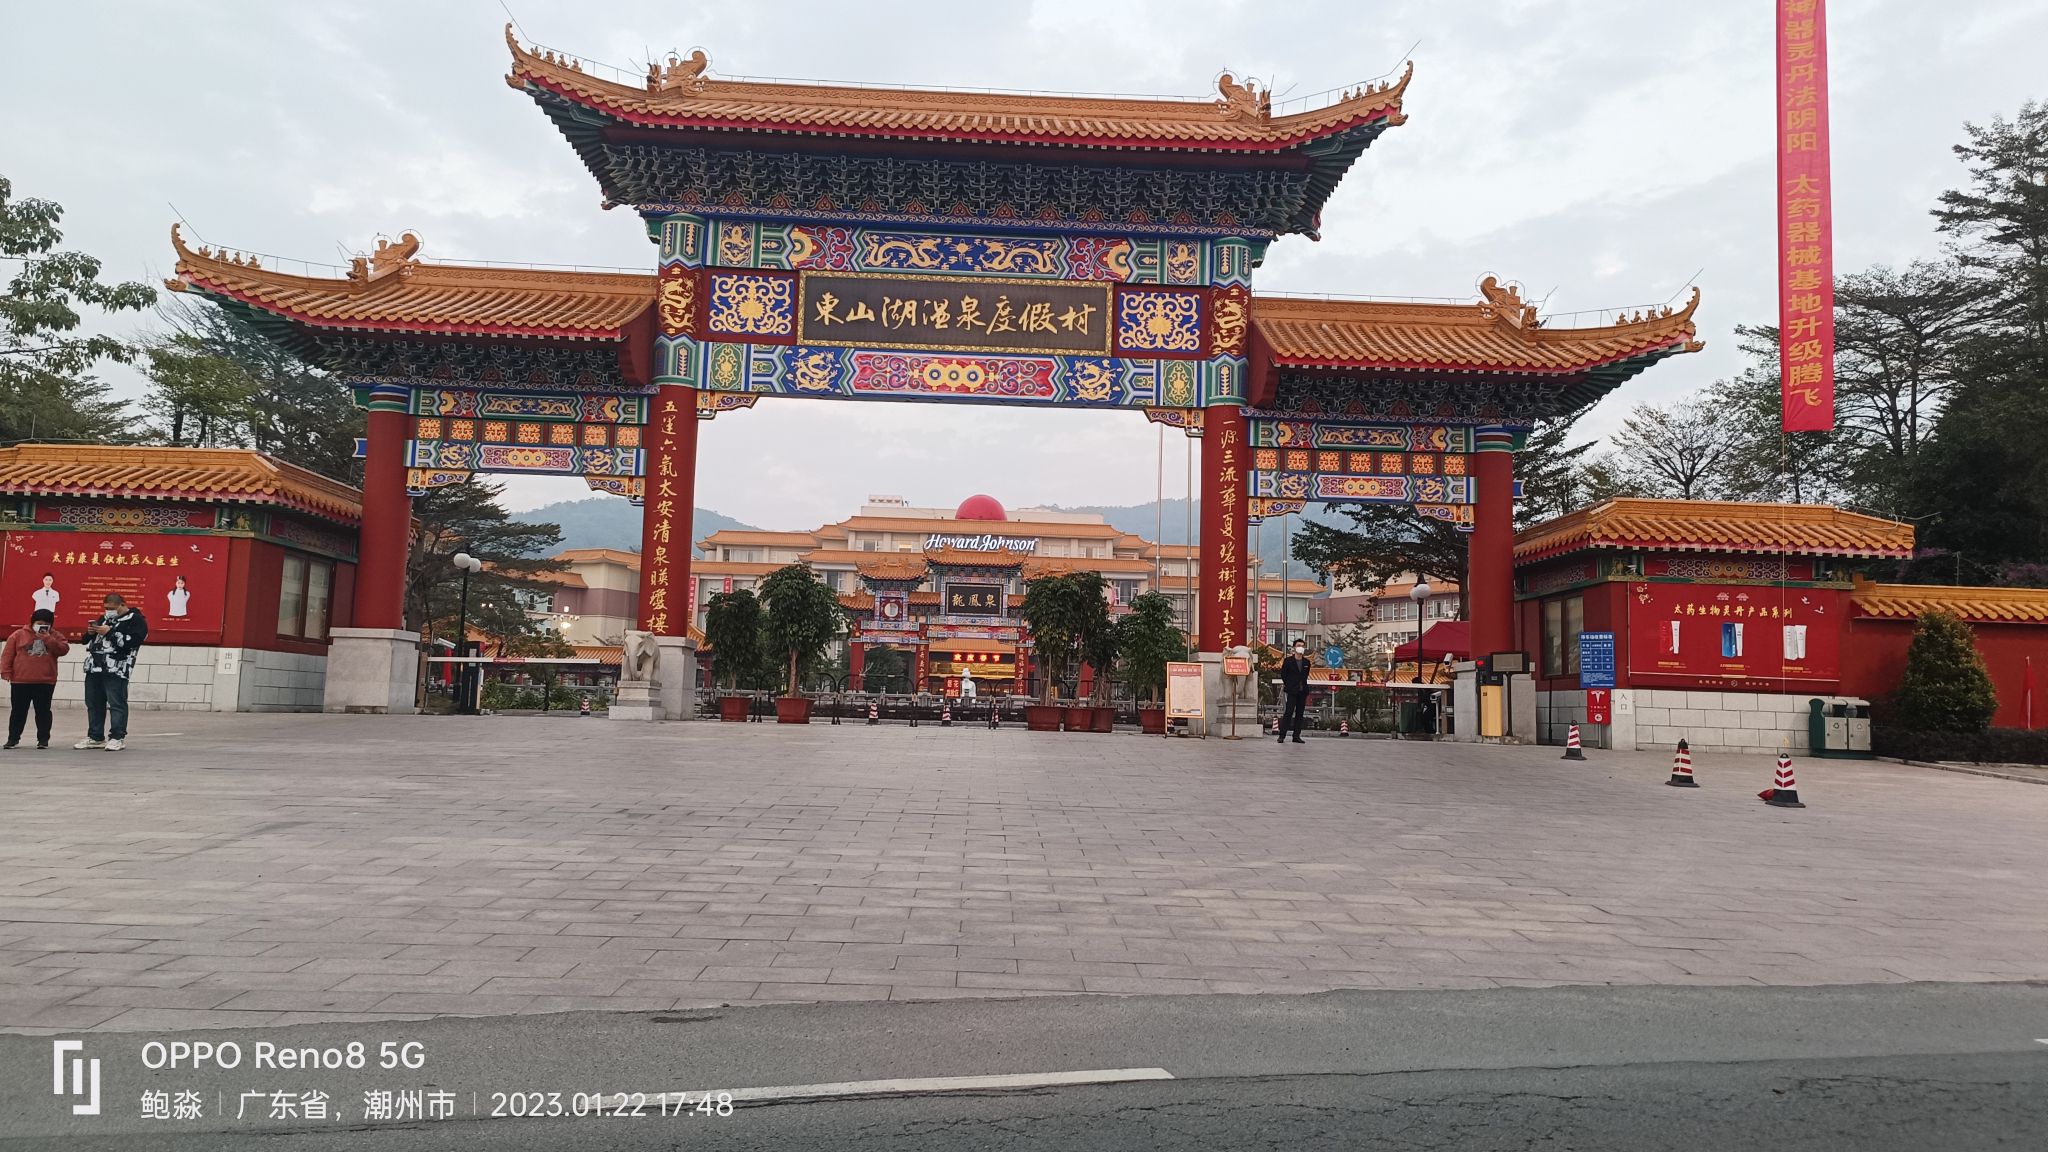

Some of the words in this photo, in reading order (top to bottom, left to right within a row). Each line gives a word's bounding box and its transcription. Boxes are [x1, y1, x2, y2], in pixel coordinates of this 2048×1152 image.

[1786, 173, 1823, 407] 太药器械基地升级腾飞
[924, 534, 981, 549] Howard
[979, 534, 1036, 551] Johnson
[1674, 603, 1793, 619] 太药生物灵丹产品系列
[224, 652, 233, 670] 出口
[1620, 694, 1628, 710] 入口
